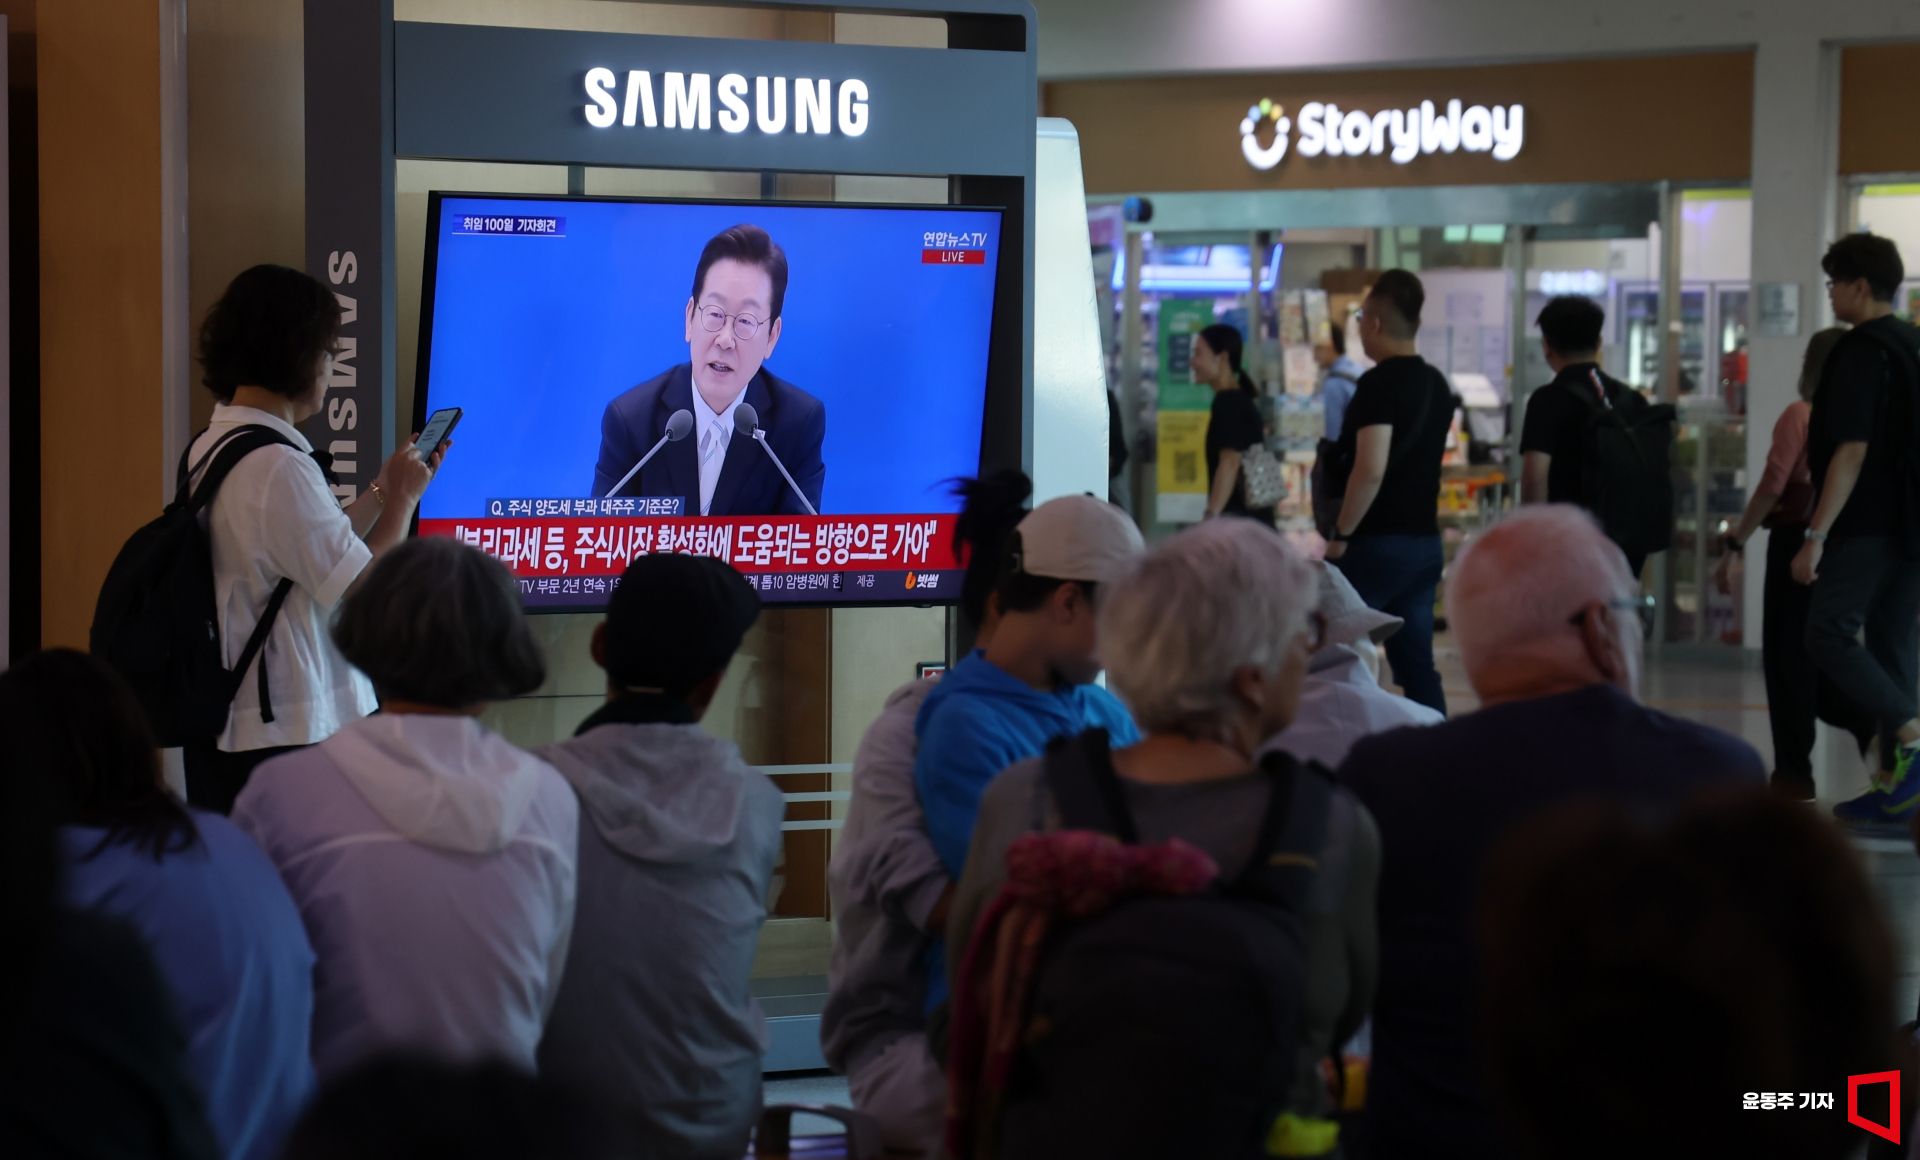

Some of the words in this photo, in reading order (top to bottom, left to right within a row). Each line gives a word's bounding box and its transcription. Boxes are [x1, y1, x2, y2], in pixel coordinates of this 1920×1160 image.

[584, 67, 869, 137] SAMSUNG
[1297, 98, 1523, 164] StoryWay
[463, 217, 513, 232] 취임100일
[517, 219, 556, 233] 기자회견
[923, 232, 987, 247] 연합뉴스TV
[941, 251, 965, 263] LIVE
[491, 501, 504, 516] Q.
[508, 500, 532, 516] 주식
[535, 500, 571, 516] 양도세
[574, 500, 598, 516] 부과
[601, 500, 635, 515] 대주주
[638, 498, 680, 515] 기준은?
[544, 526, 569, 574] 등,
[574, 525, 654, 569] 주식시장
[734, 524, 811, 565] 도움되는
[815, 523, 888, 565] 방향으로
[892, 520, 937, 563] 가야"
[519, 579, 535, 594] TV
[537, 578, 560, 595] 부문
[562, 578, 580, 594] 2년
[584, 577, 606, 594] 연속
[761, 574, 784, 590] 톱10
[786, 573, 830, 590] 암병원에
[857, 574, 875, 588] 제공
[916, 573, 940, 589] 빗썸
